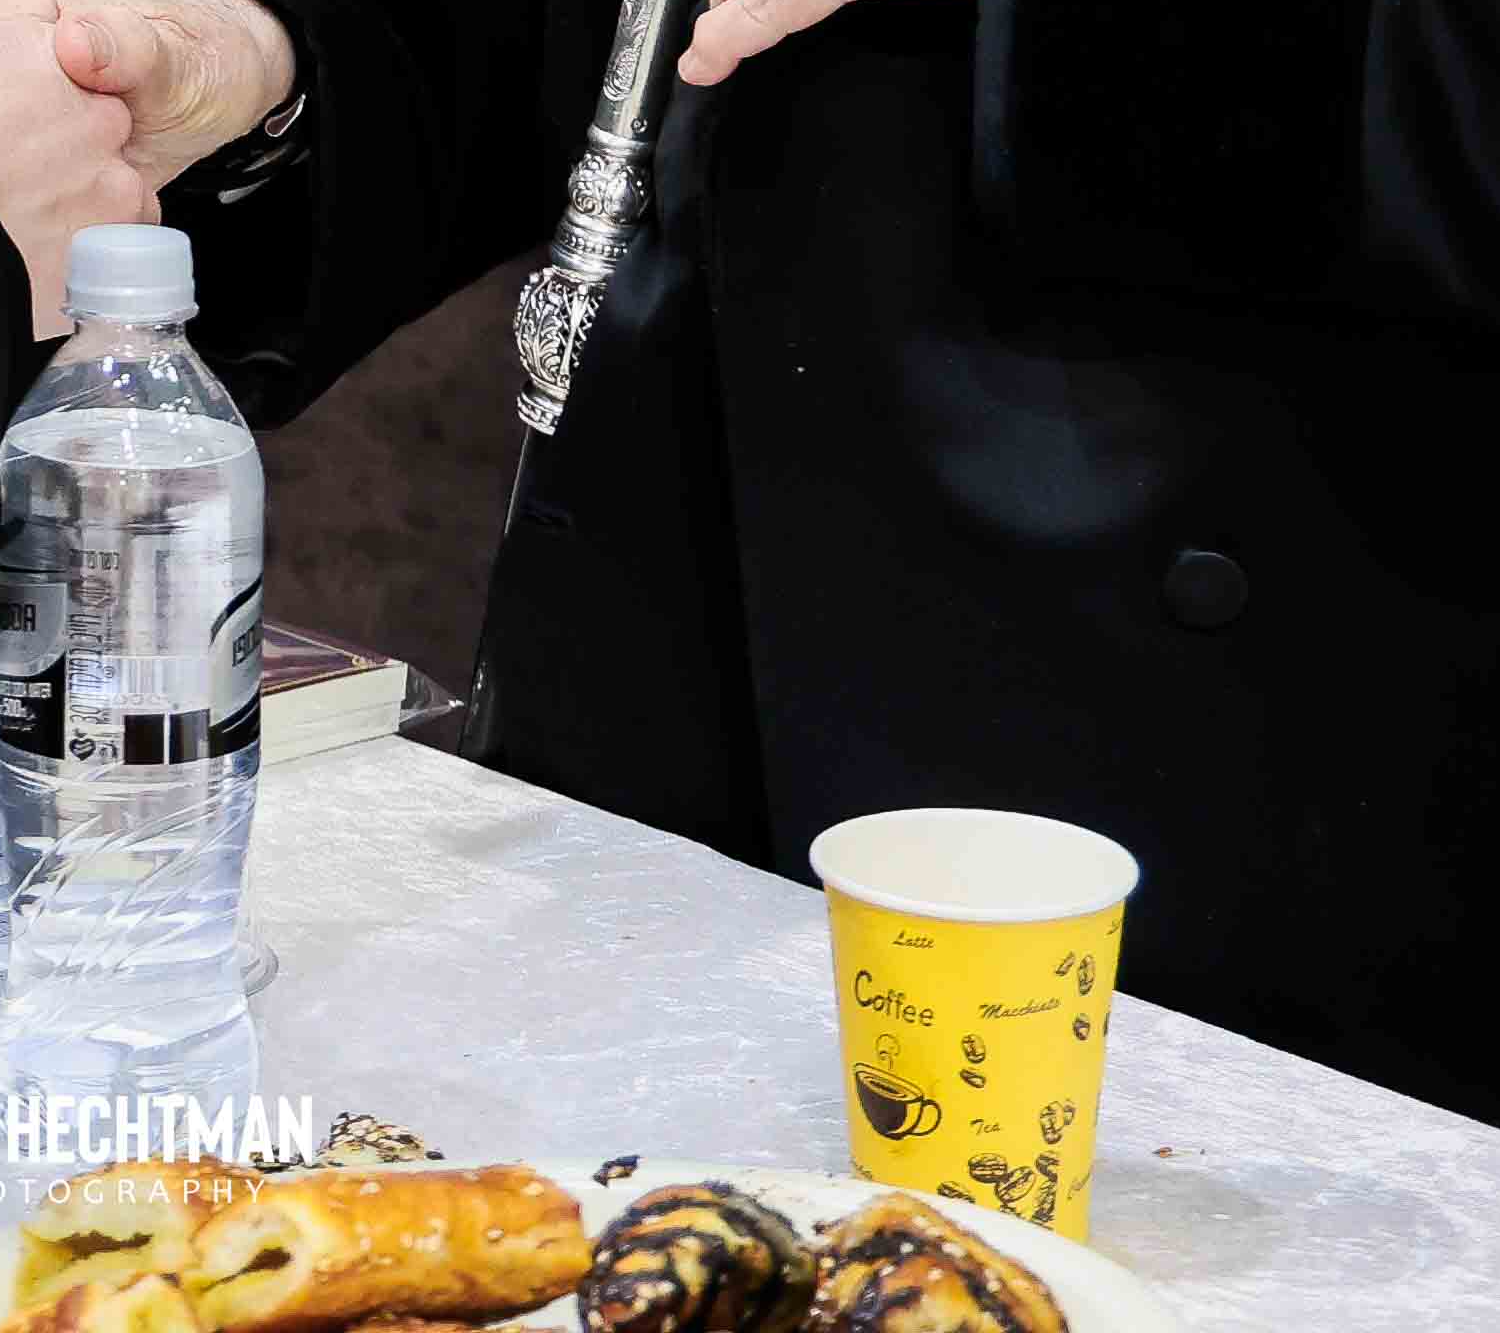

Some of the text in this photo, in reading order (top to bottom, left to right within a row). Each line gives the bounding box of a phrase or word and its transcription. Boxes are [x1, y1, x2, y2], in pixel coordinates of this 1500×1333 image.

[892, 929, 934, 948] Latte
[855, 969, 934, 1027] Coffee
[969, 1118, 1001, 1135] Tea
